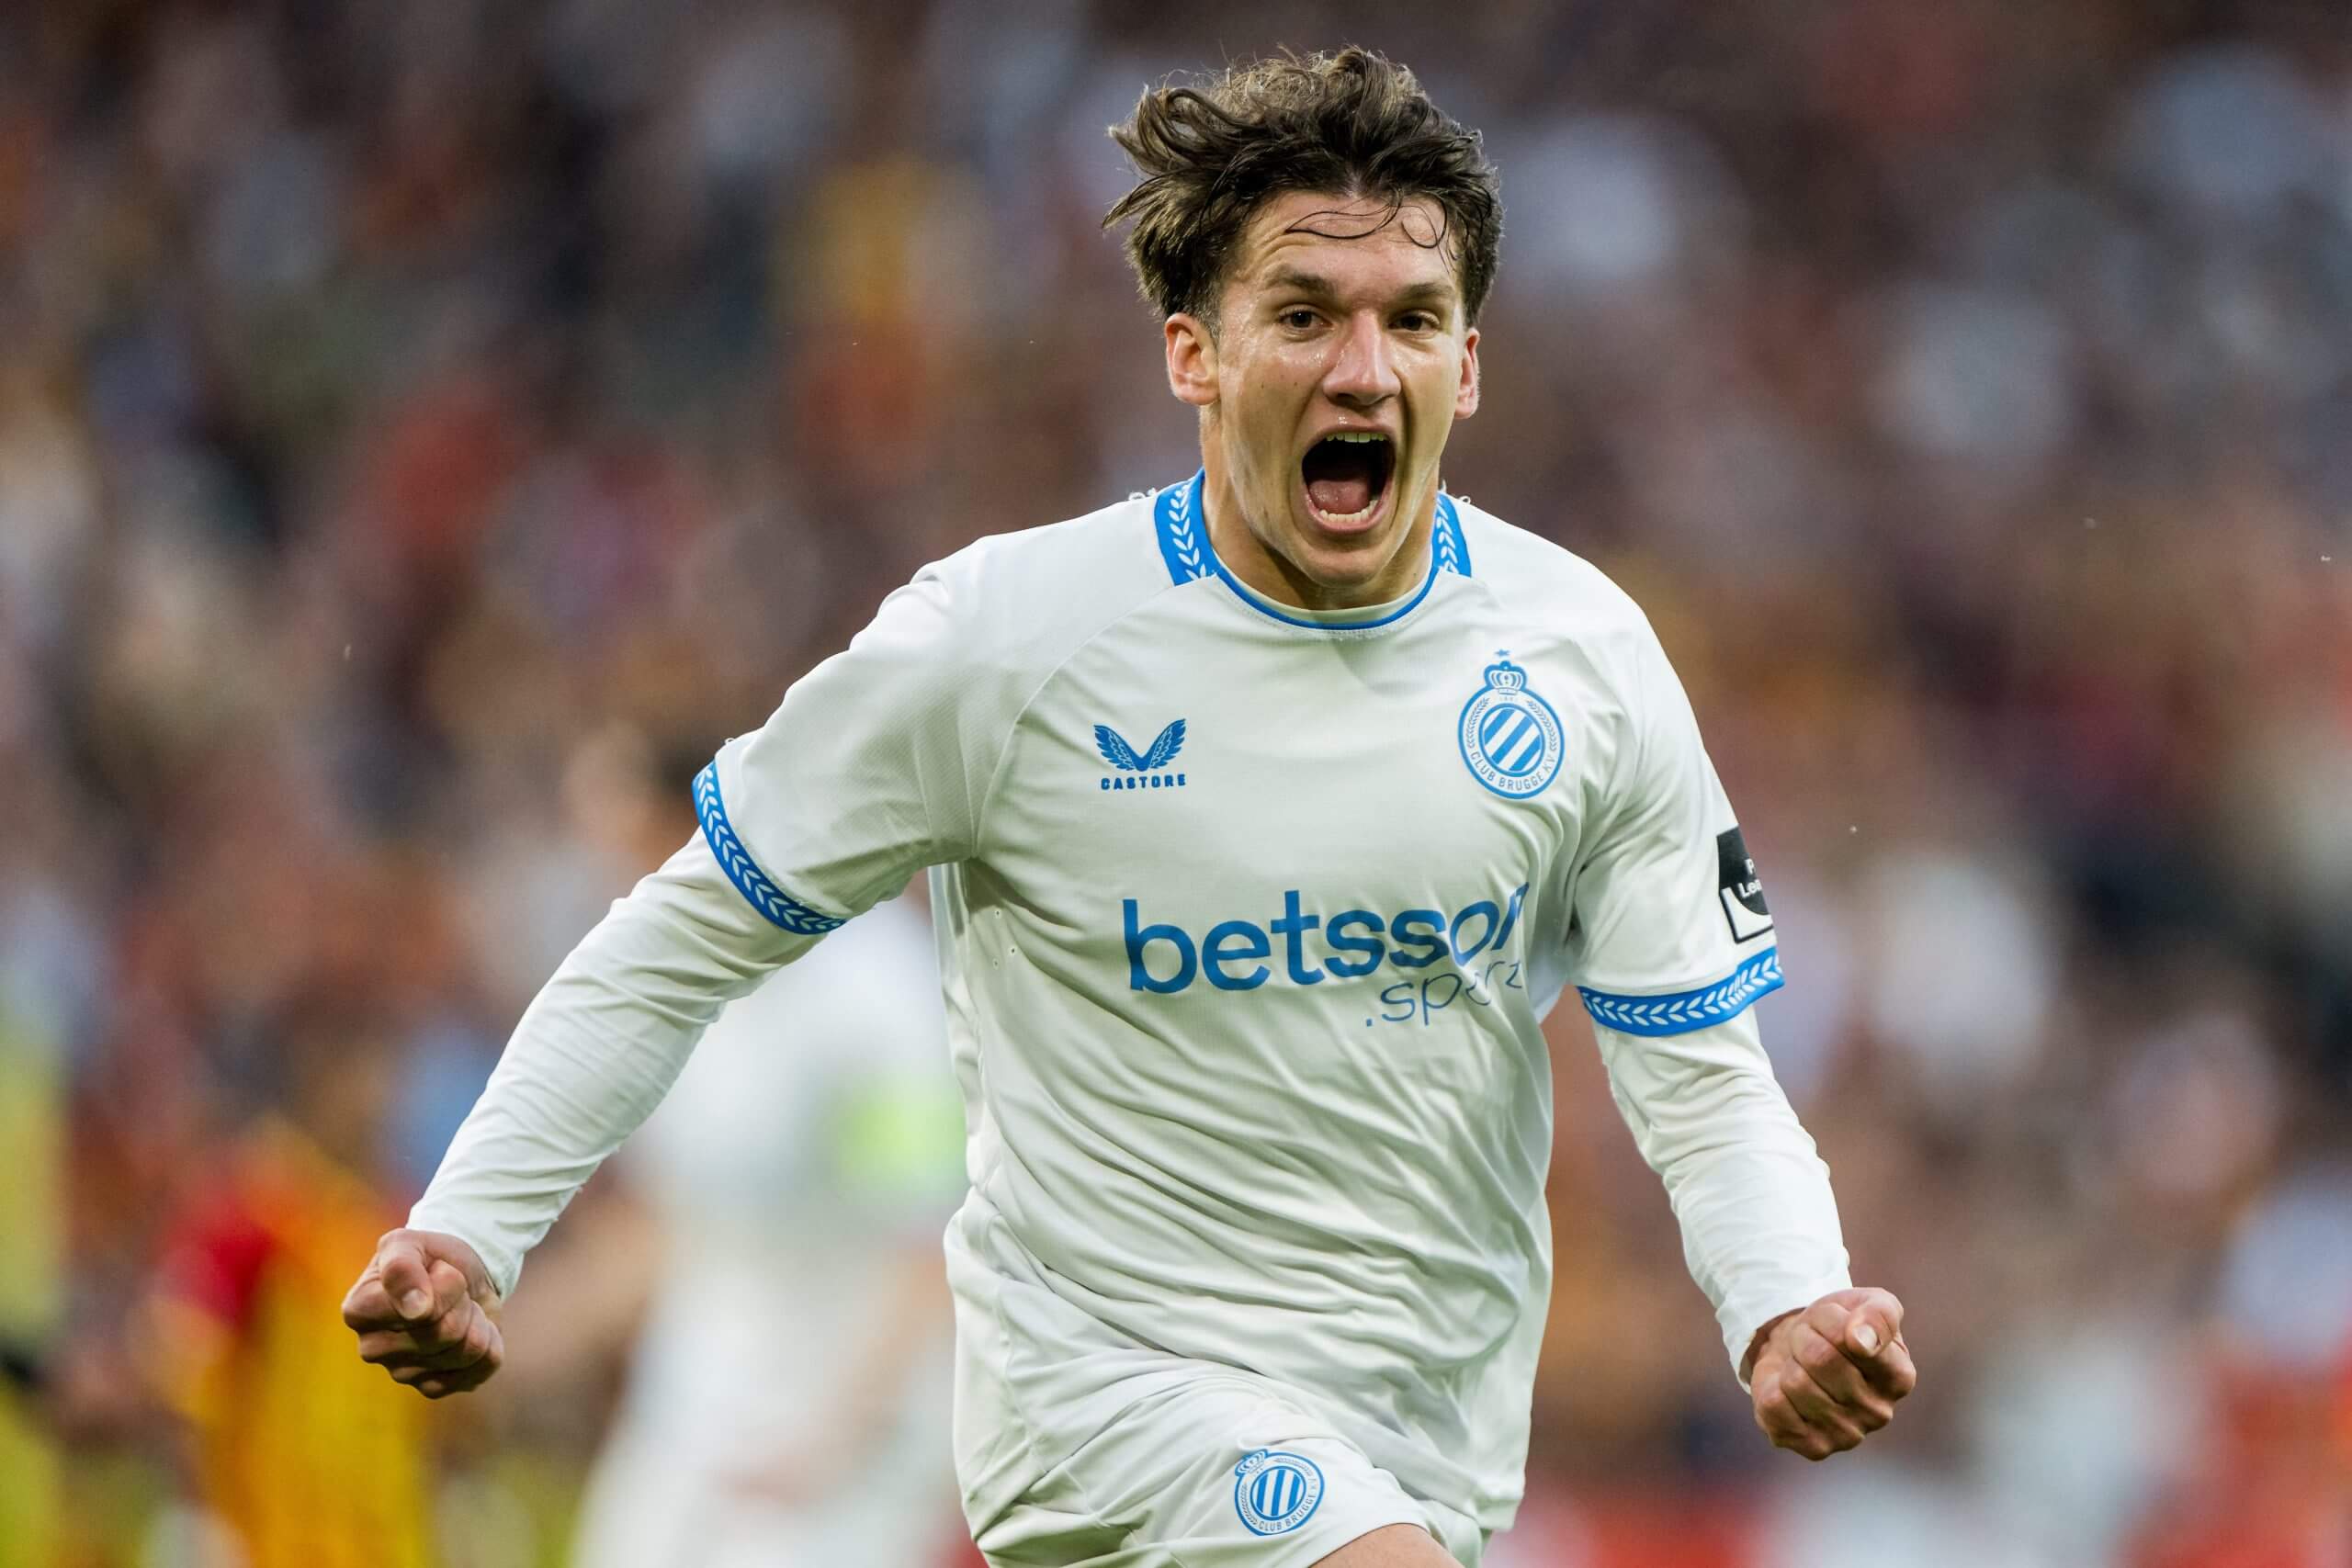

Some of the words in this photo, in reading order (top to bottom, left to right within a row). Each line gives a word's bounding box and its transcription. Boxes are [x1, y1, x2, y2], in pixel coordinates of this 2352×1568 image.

[1470, 750, 1498, 781] CLUB
[1498, 772, 1544, 791] BRUGGE
[1101, 773, 1186, 790] CASTORE
[1259, 1520, 1283, 1532] CLUB
